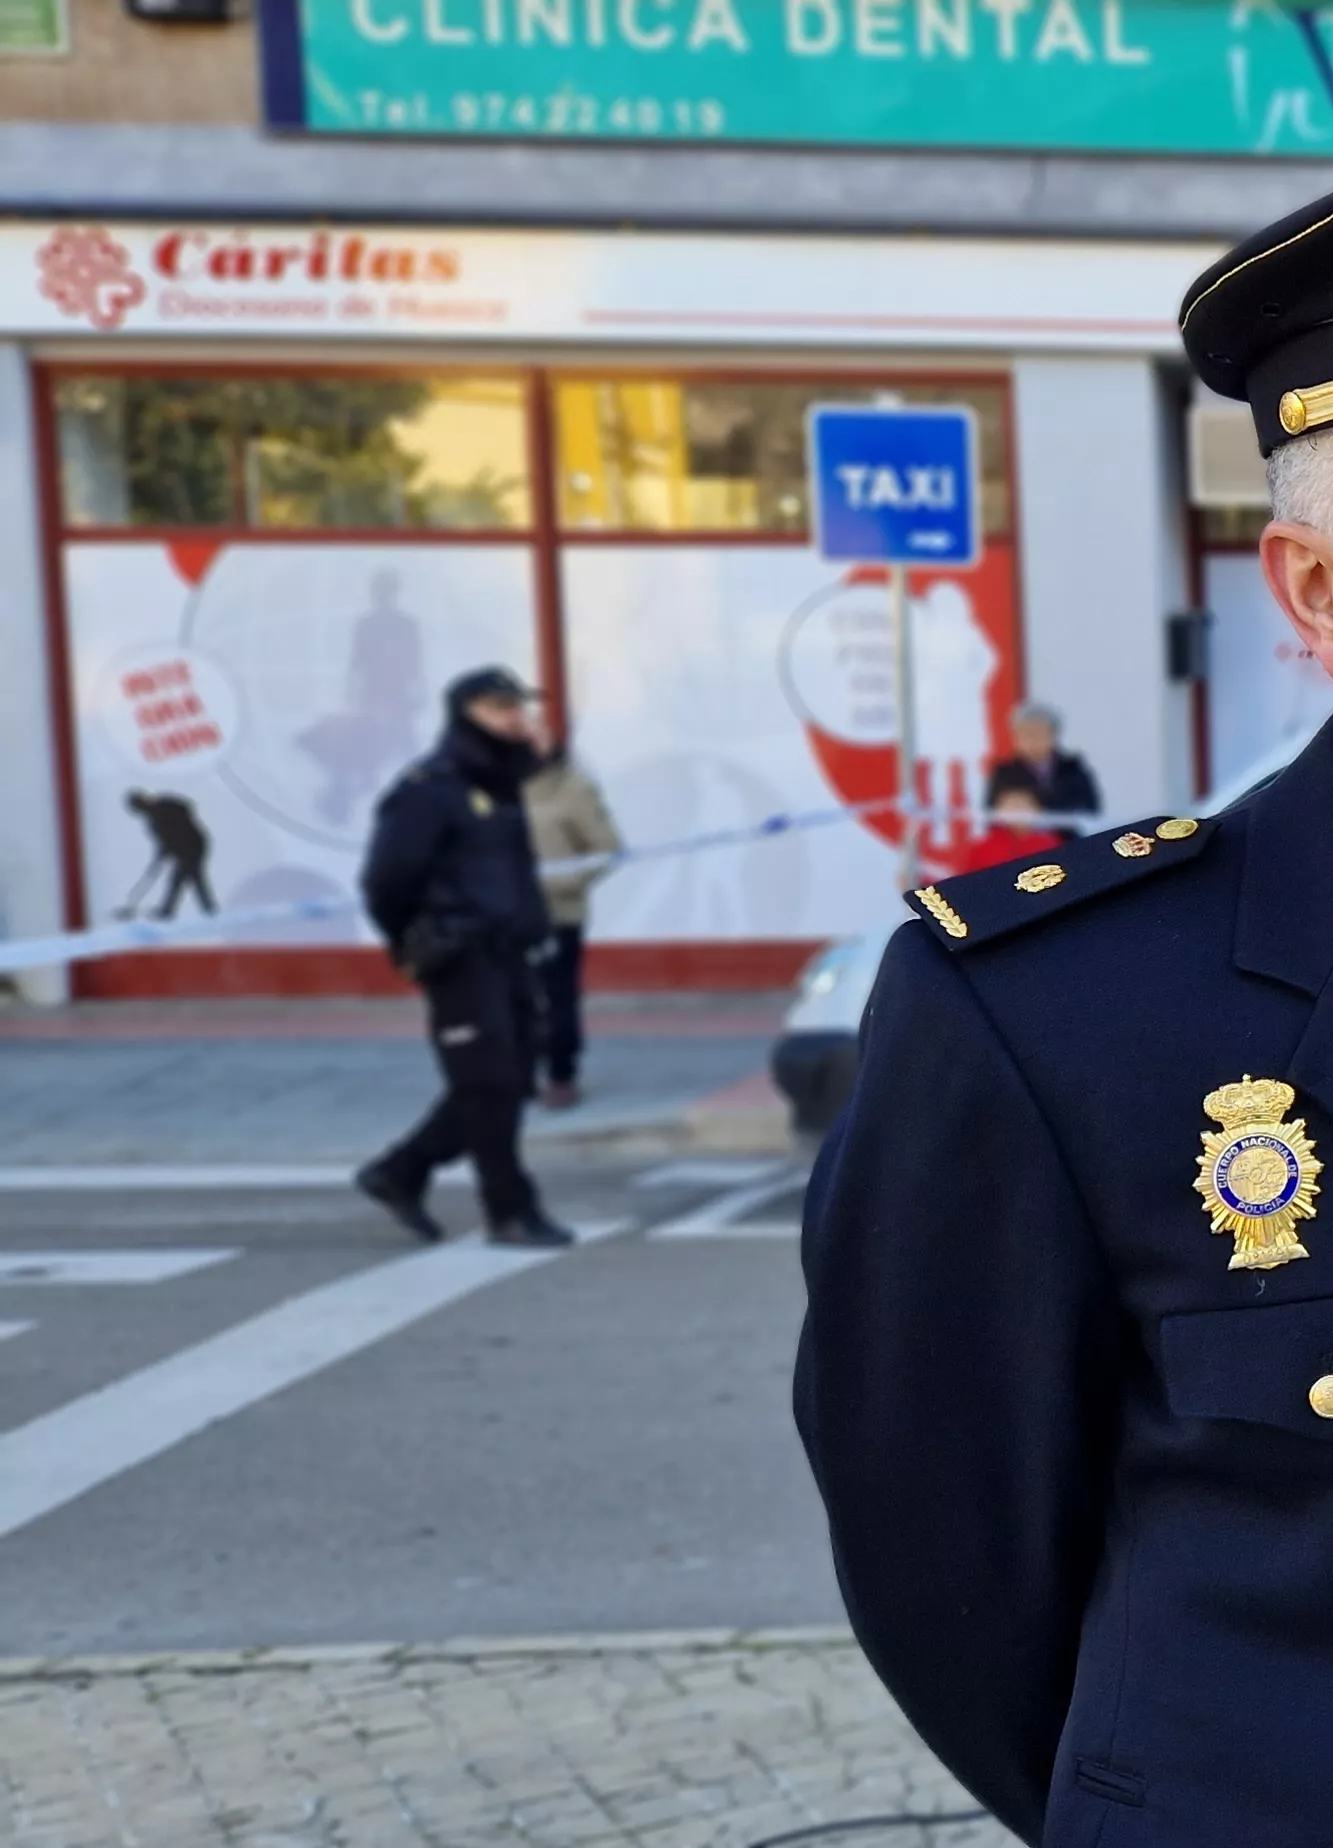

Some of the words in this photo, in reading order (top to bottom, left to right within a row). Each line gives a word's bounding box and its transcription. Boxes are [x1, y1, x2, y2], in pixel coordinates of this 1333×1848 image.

[784, 0, 1153, 66] DENTAL
[153, 229, 461, 284] Cáritas
[834, 463, 957, 512] TAXI
[1217, 1148, 1239, 1189] CUERPO
[1241, 1136, 1292, 1164] NACIONAL
[1288, 1164, 1298, 1178] DE
